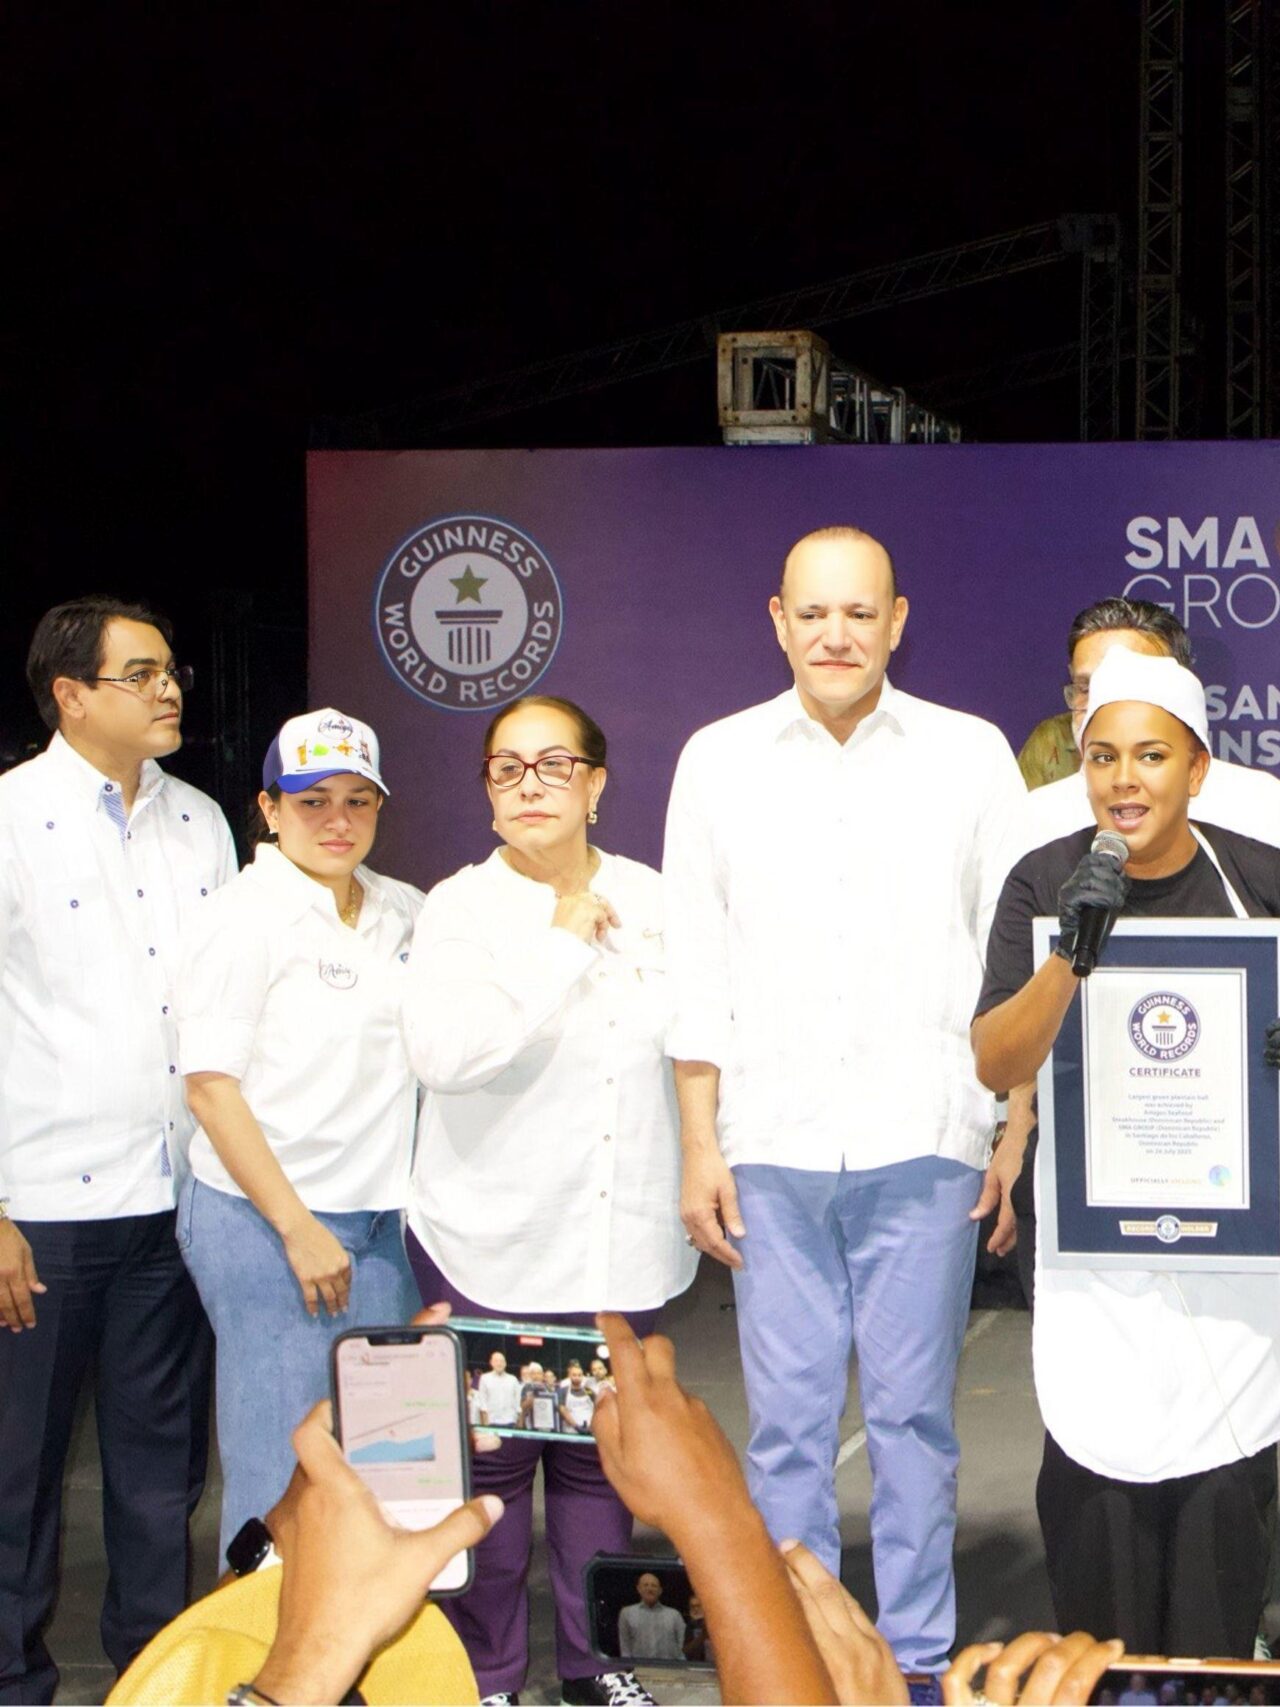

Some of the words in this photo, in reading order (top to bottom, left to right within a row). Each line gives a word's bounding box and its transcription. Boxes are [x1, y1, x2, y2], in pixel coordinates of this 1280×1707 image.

[400, 525, 540, 578] GUINNESS
[1124, 516, 1270, 570] SMA
[385, 603, 447, 694] WORLD
[459, 601, 554, 701] RECORDS
[1138, 995, 1191, 1015] GUINNESS
[1132, 1022, 1157, 1056] WORLD
[1160, 1022, 1197, 1059] RECORDS
[1129, 1068, 1201, 1077] CERTIFICATE
